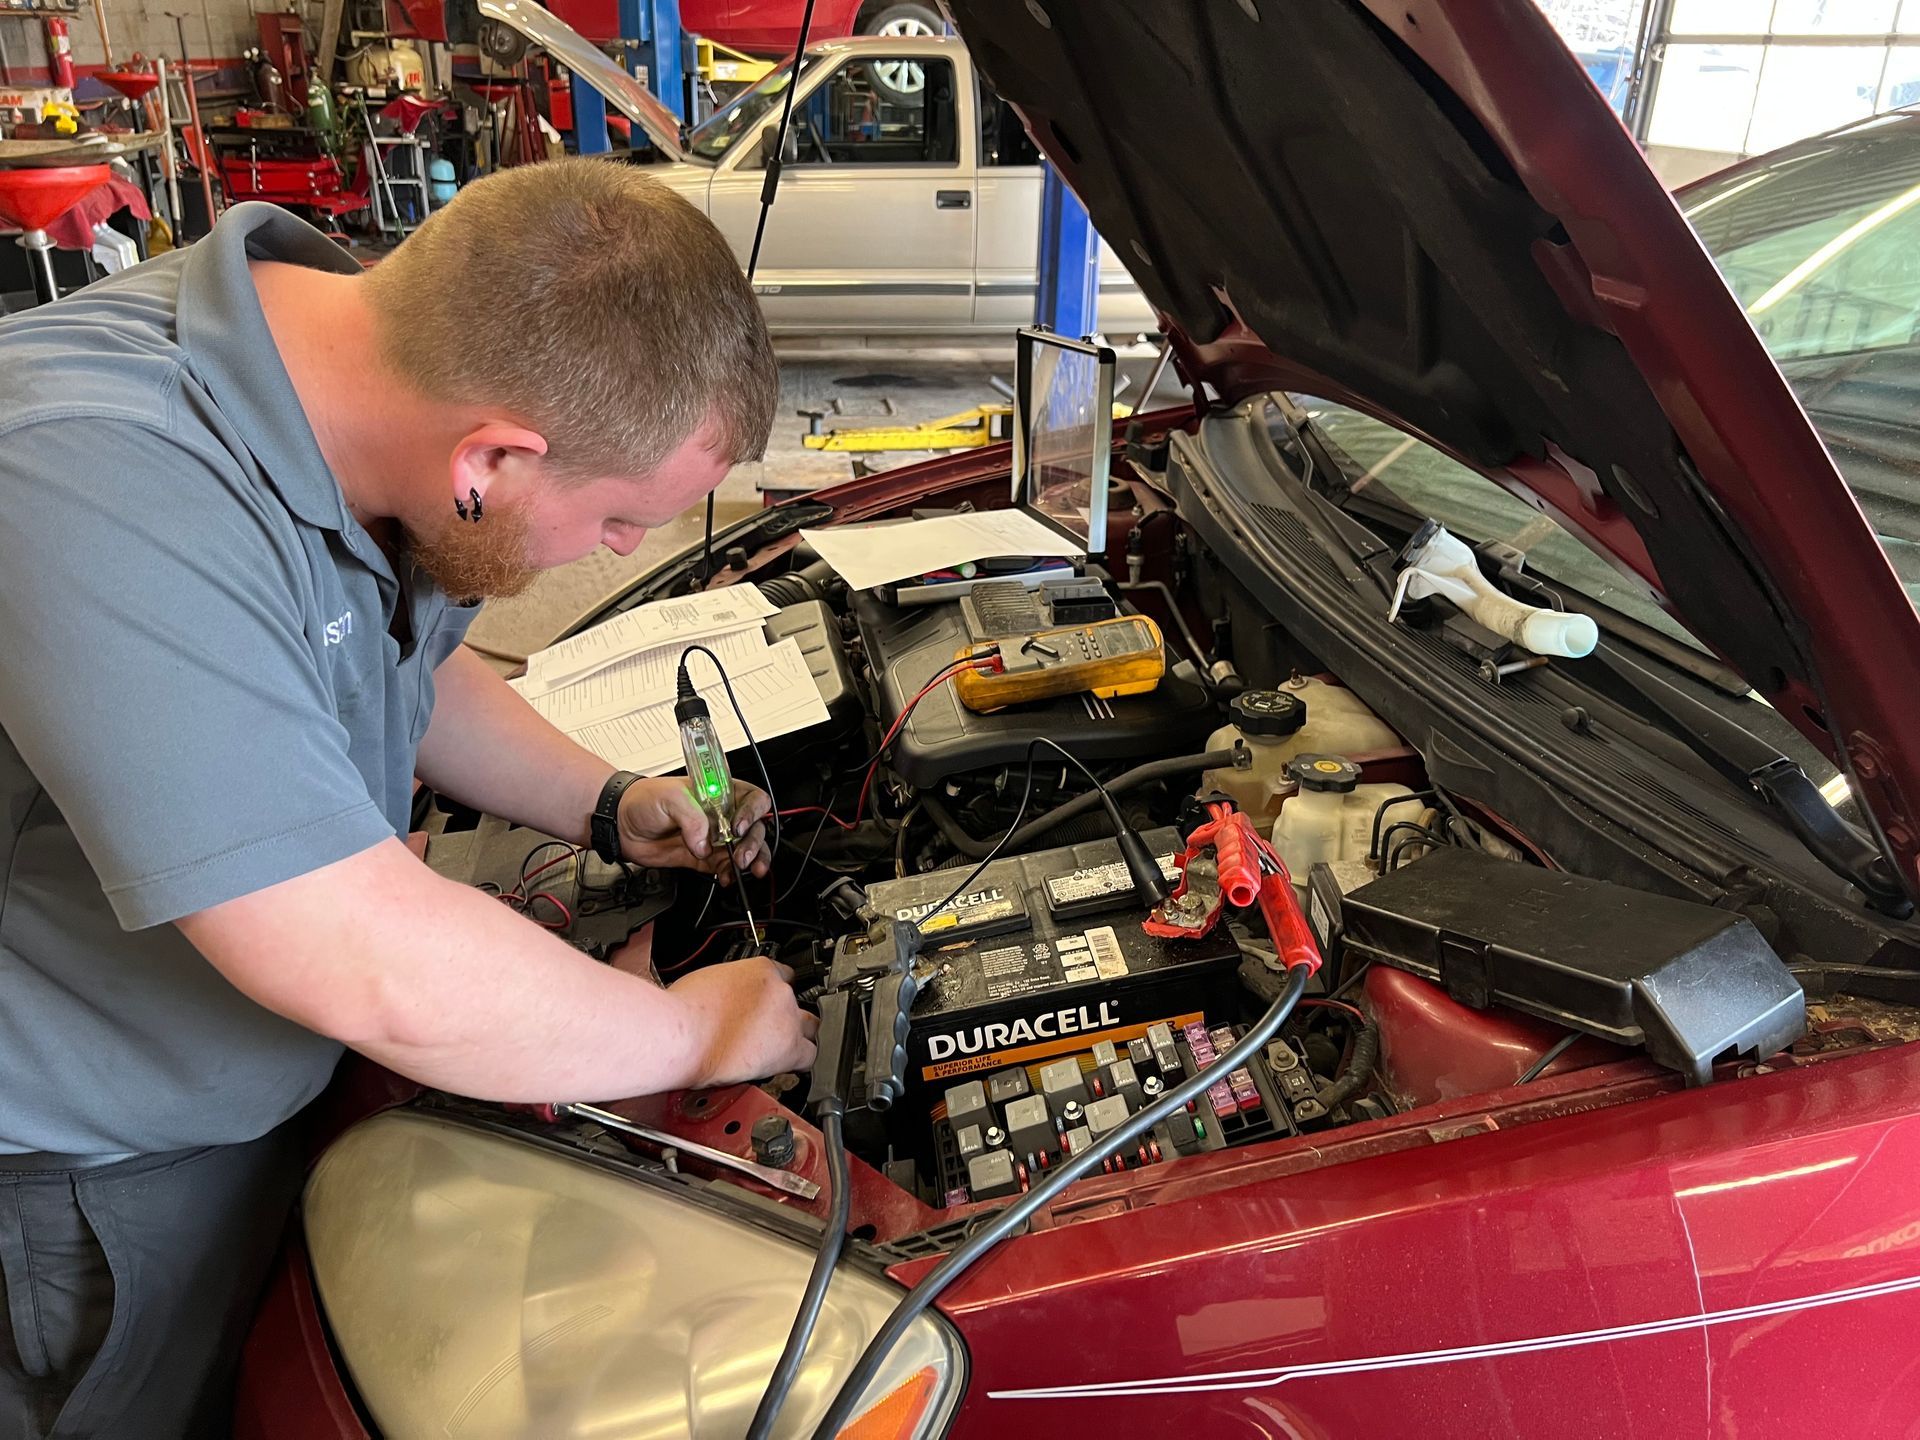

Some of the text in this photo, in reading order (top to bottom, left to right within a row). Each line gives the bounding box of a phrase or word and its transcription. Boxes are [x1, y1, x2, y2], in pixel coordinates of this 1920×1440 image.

[933, 1055, 991, 1072] SUPERIOR LIFE
[942, 1059, 1002, 1077] PERFORMANCE
